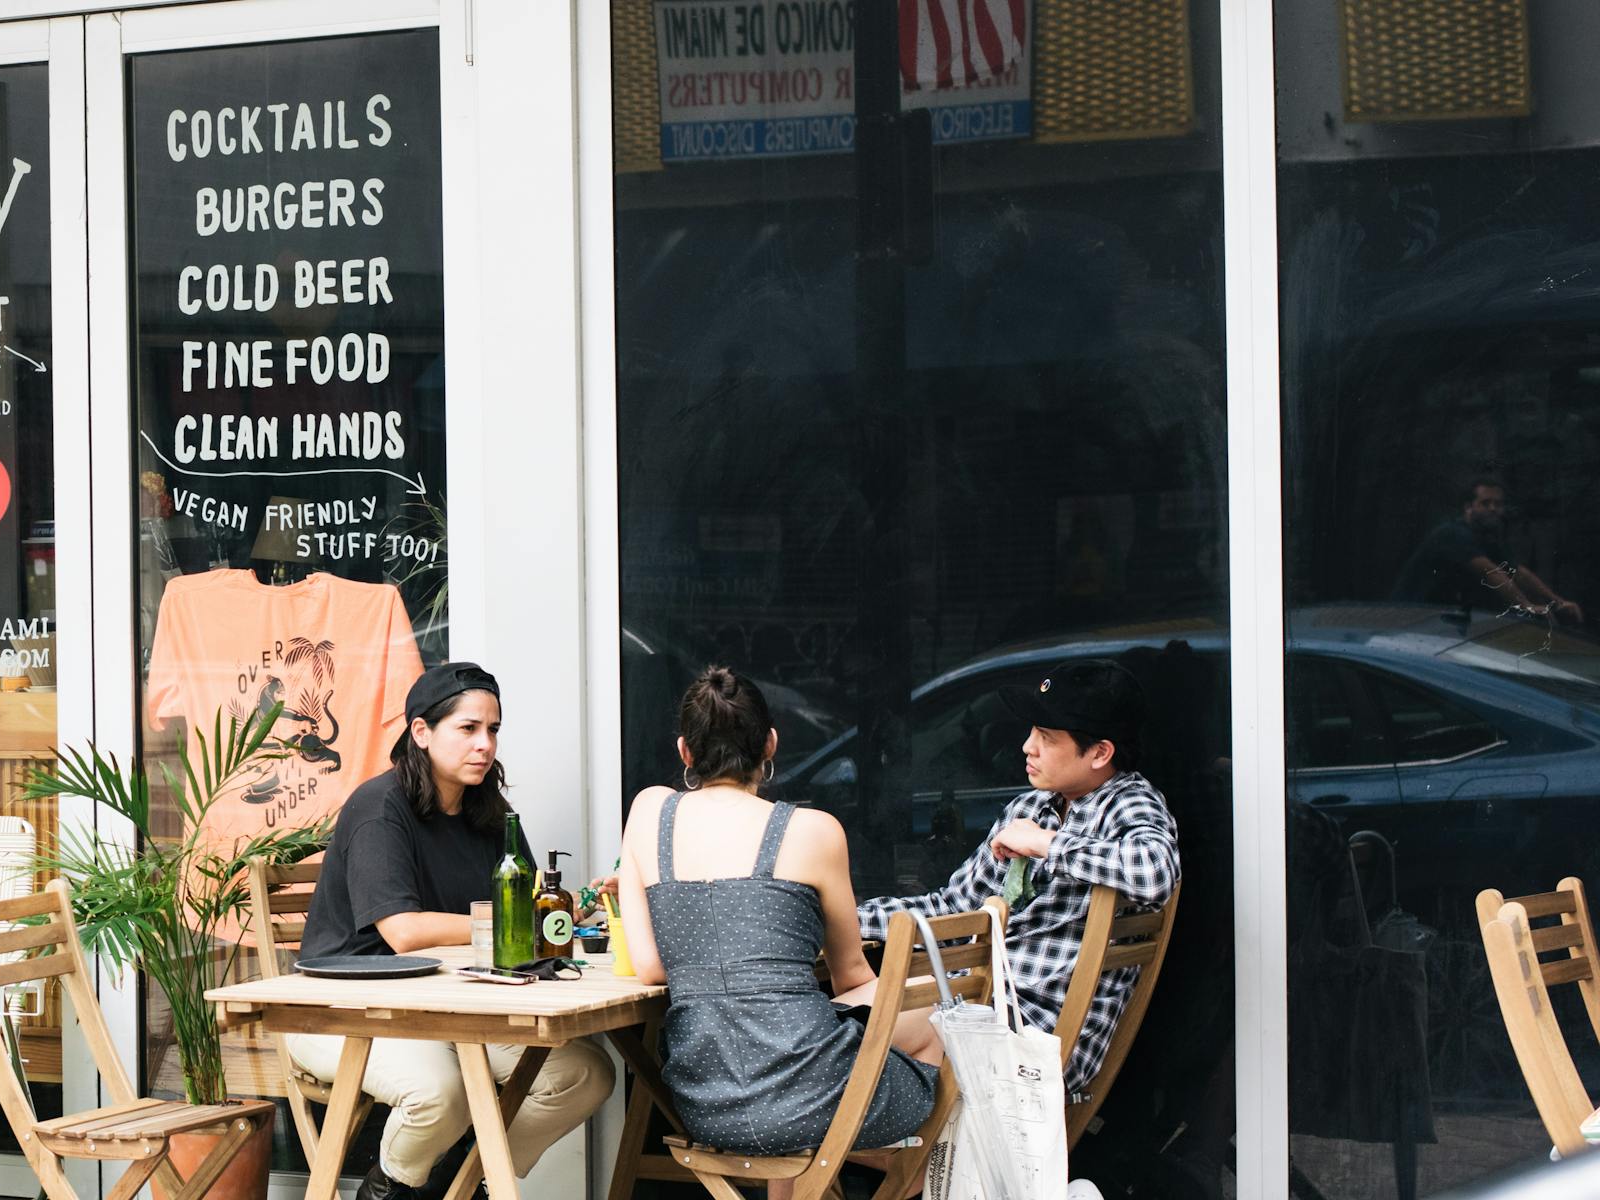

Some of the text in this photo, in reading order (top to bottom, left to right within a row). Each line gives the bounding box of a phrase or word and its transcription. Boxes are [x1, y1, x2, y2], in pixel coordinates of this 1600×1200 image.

[167, 94, 391, 162] COCKTAILS
[196, 178, 384, 236] BURGERS
[179, 257, 393, 315] COLD BEER
[183, 333, 389, 392] FINE FOOD
[175, 411, 405, 464] CLEAN HANDS
[174, 488, 377, 531] VEGAN FRIENDLY
[297, 534, 438, 569] STUFF TOO!
[238, 641, 283, 694] OVER
[265, 777, 318, 828] UNDER
[554, 919, 565, 935] 2
